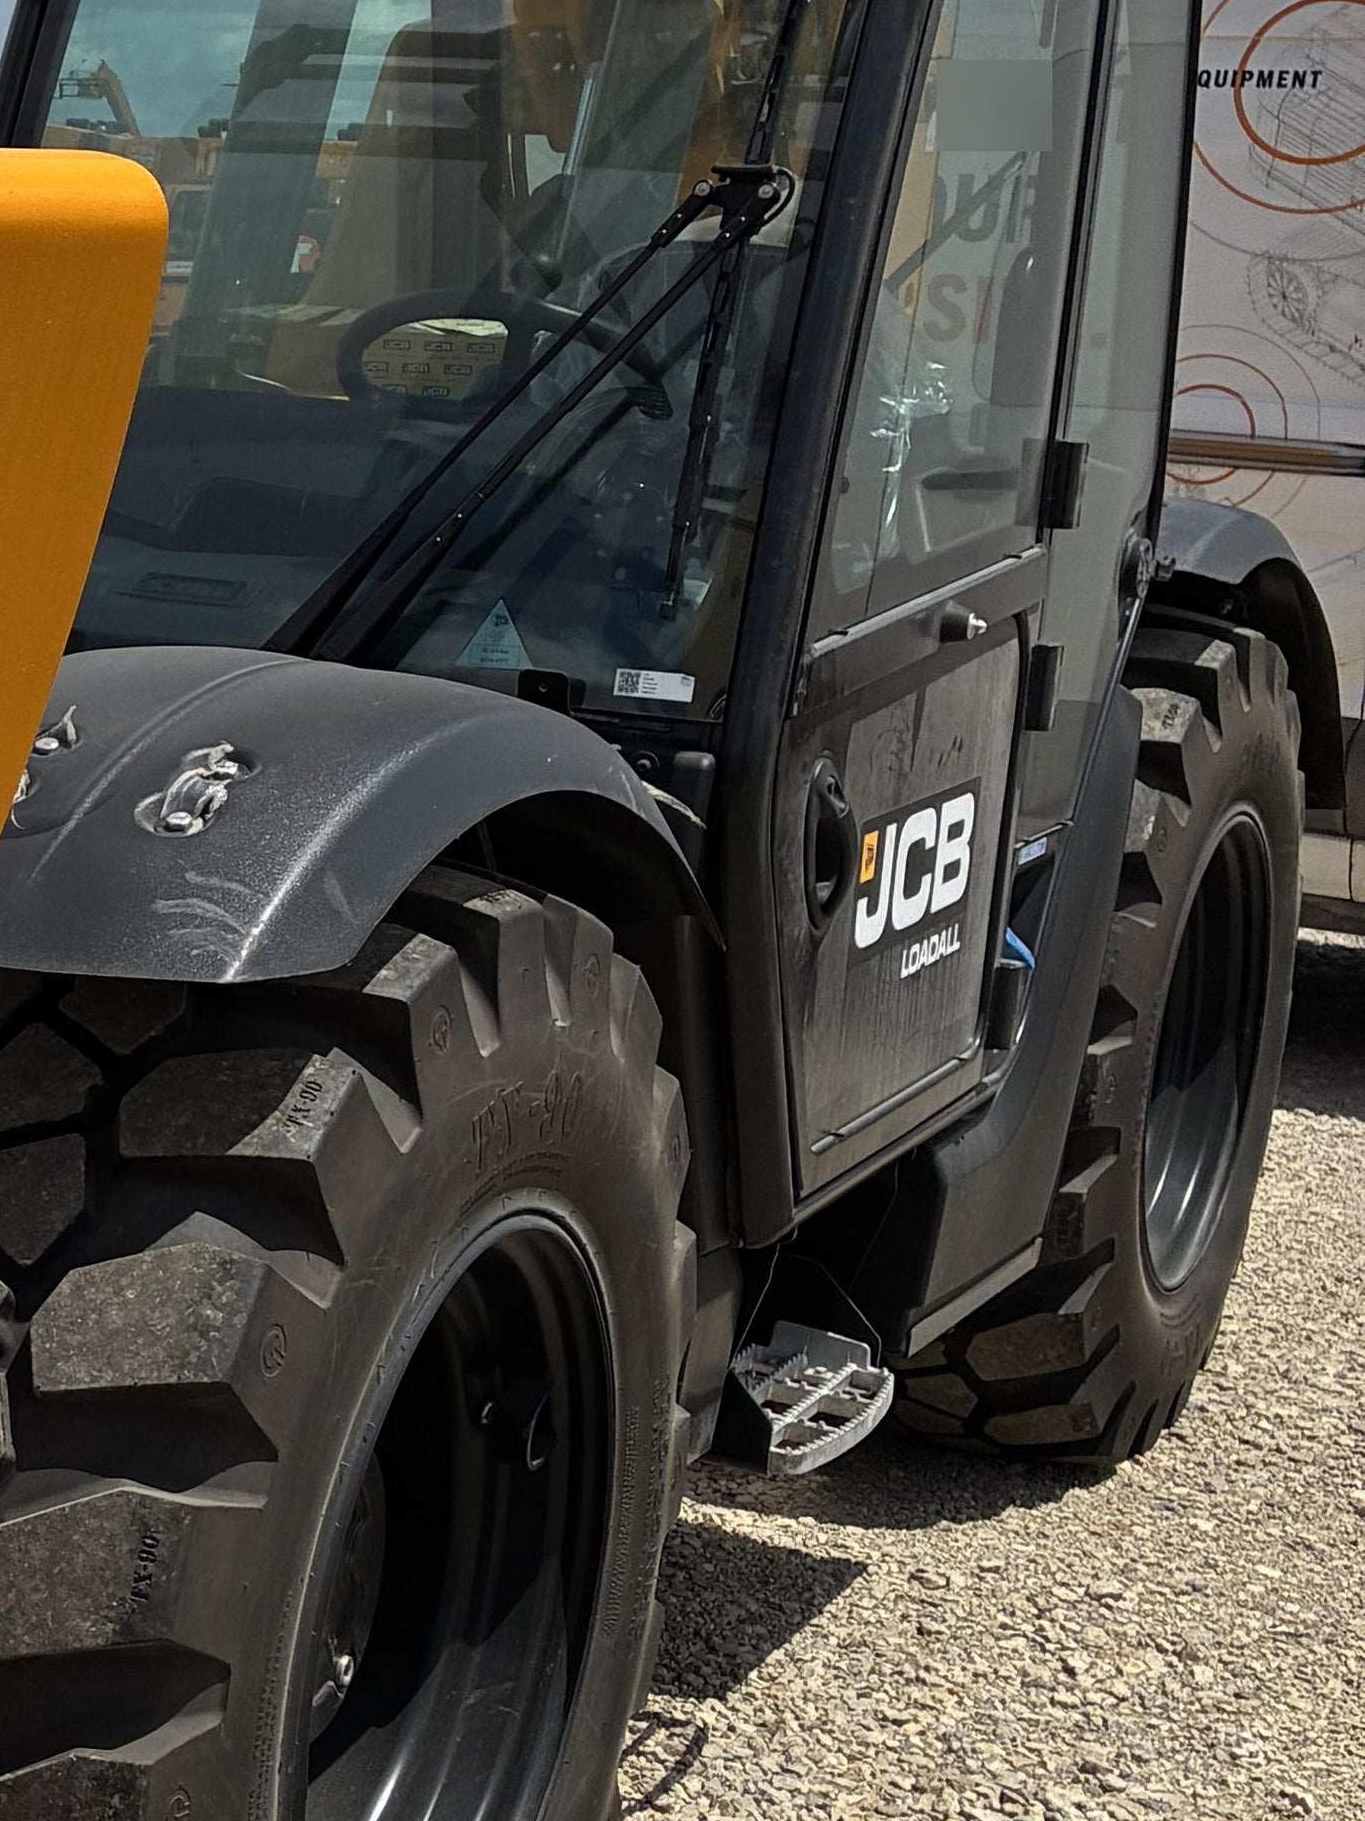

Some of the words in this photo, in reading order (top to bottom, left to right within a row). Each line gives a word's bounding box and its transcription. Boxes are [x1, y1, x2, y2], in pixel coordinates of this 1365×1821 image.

[1198, 69, 1323, 89] QUIPMENT
[855, 792, 974, 949] JCB
[900, 923, 961, 979] LOADALL
